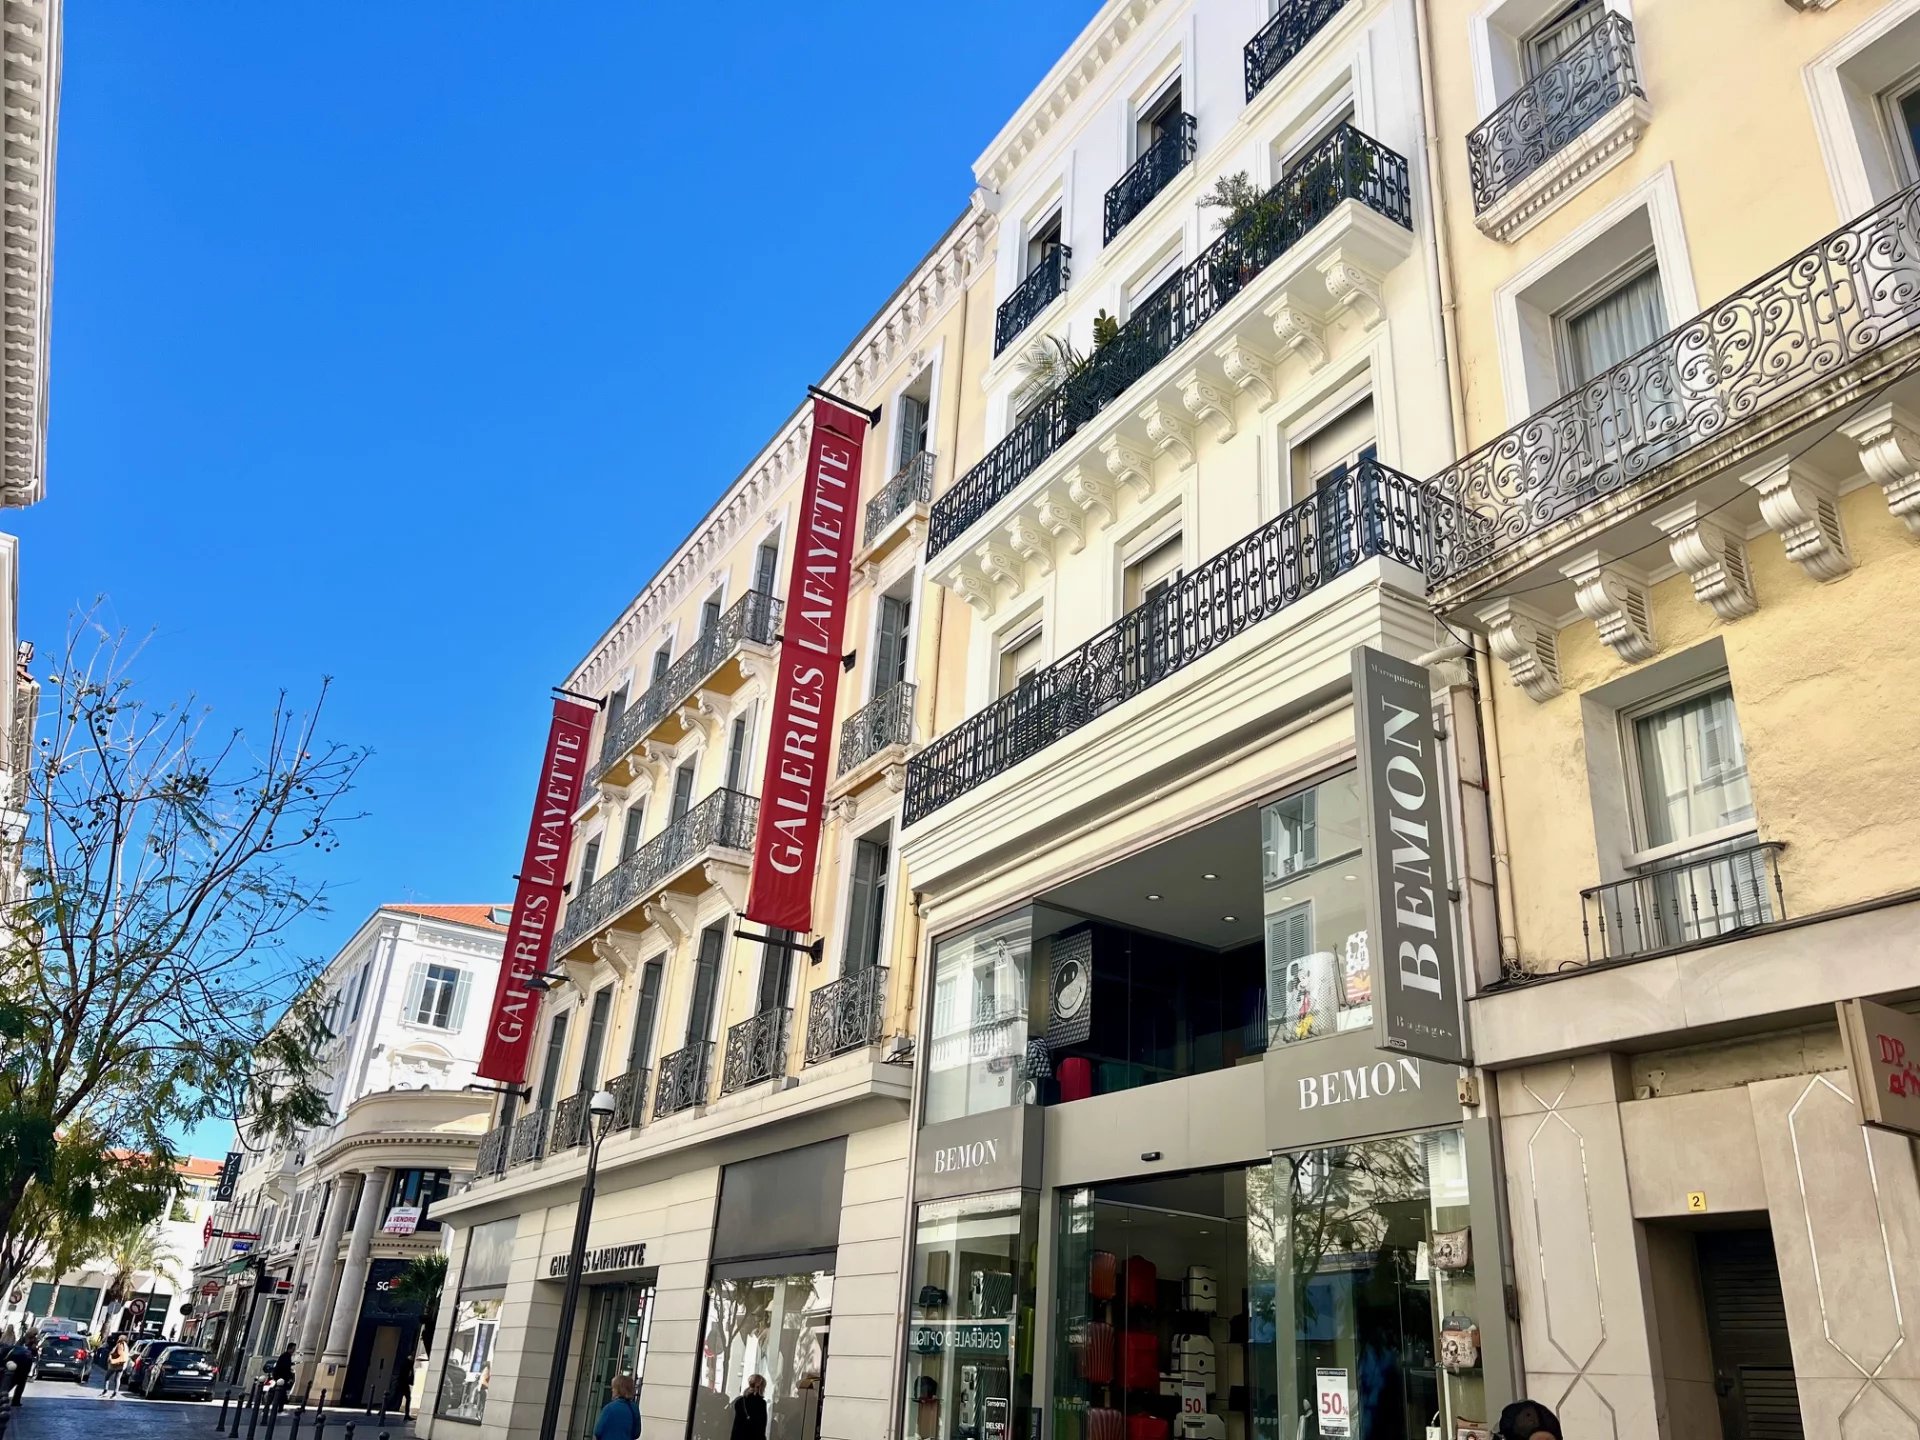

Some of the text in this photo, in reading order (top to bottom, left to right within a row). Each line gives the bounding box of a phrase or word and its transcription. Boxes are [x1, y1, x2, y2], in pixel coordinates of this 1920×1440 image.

[768, 443, 851, 875] GALERIES LAFAYETTE
[1381, 694, 1442, 1001] BEMON
[497, 731, 581, 1043] GALERIES LAFAYETTE
[1297, 1056, 1421, 1111] BEMON
[934, 1138, 999, 1174] BEMON
[1692, 1195, 1701, 1208] 2
[590, 1242, 647, 1272] LAFAYETTE
[376, 1281, 389, 1291] SG
[985, 1421, 1005, 1430] DELSEY
